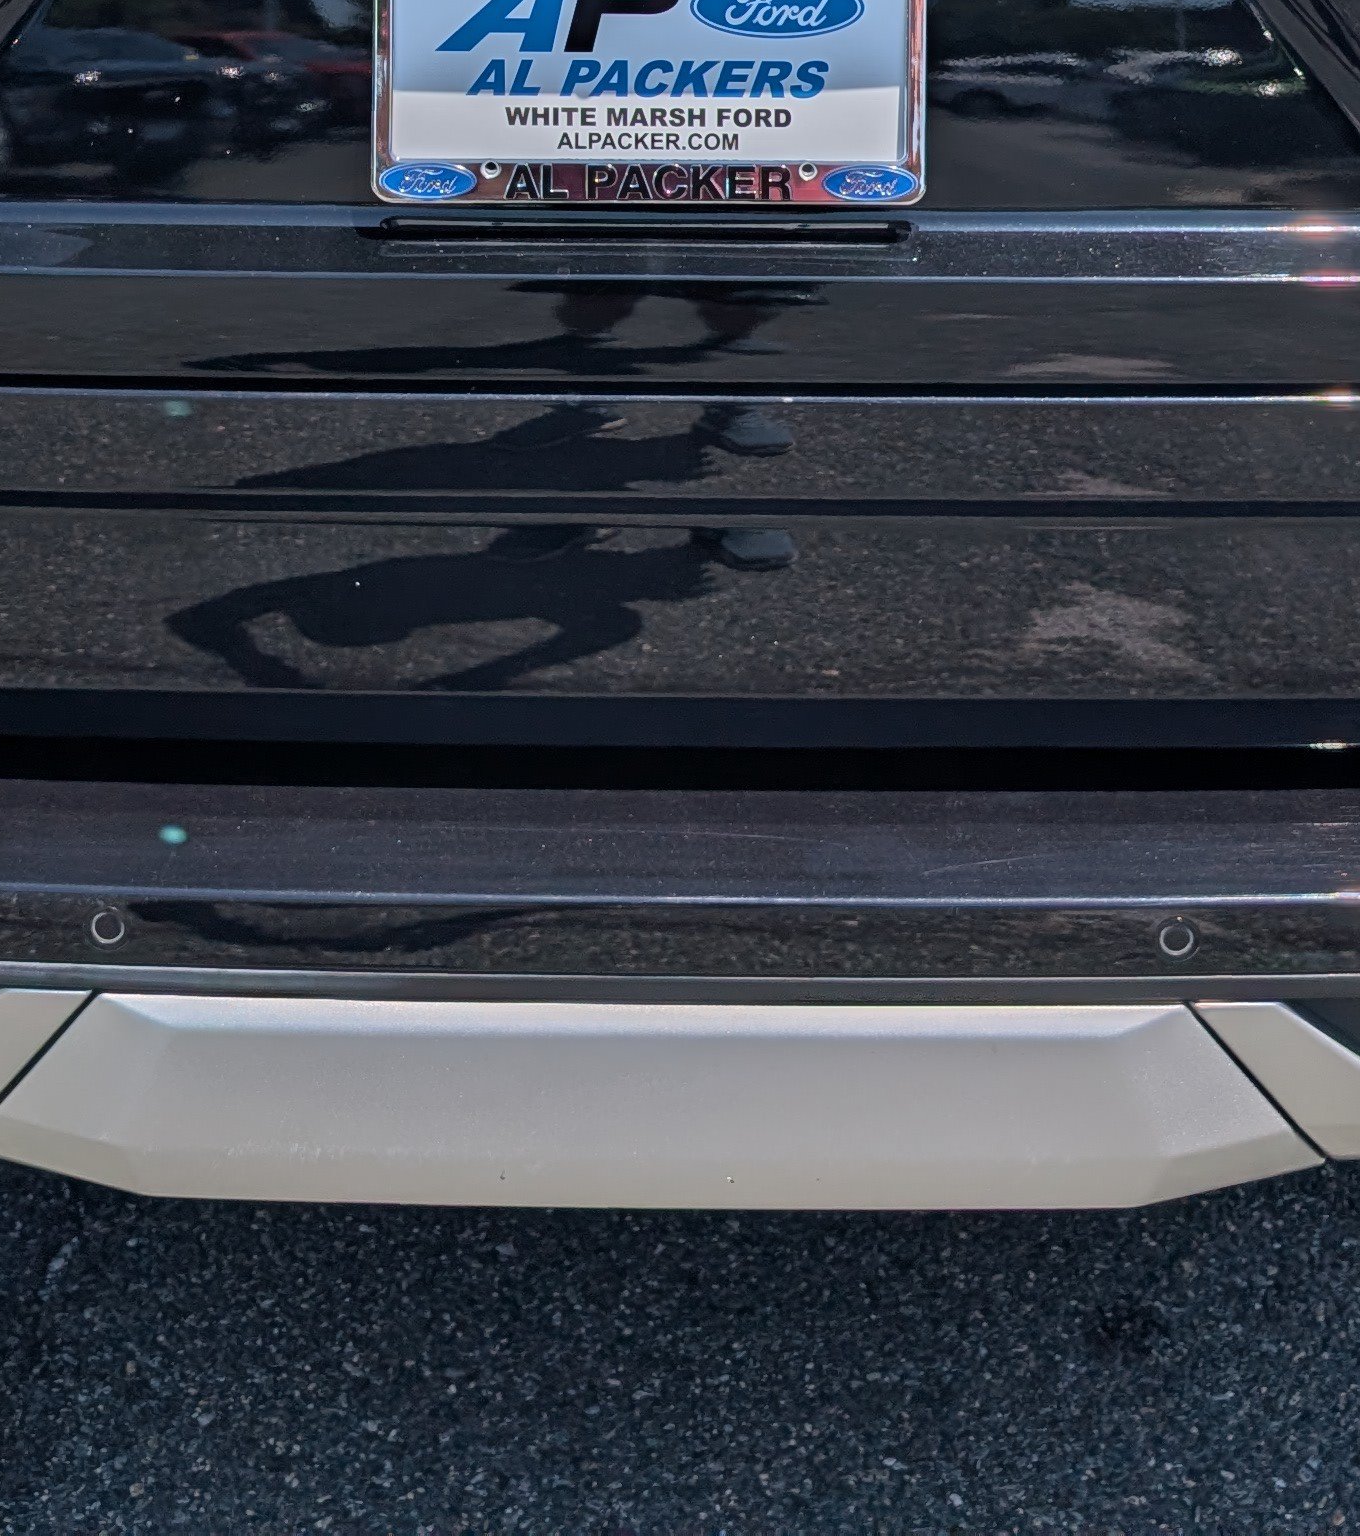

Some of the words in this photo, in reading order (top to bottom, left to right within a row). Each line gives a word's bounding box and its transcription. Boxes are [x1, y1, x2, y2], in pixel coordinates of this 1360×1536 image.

[466, 59, 540, 96] AL
[559, 60, 829, 98] PACKERS
[505, 107, 596, 126] WHITE
[606, 108, 706, 127] MARSH
[716, 109, 792, 128] FORD
[557, 132, 740, 151] ALPACKER.COM
[505, 166, 568, 201] AL
[587, 165, 792, 201] PACKER
